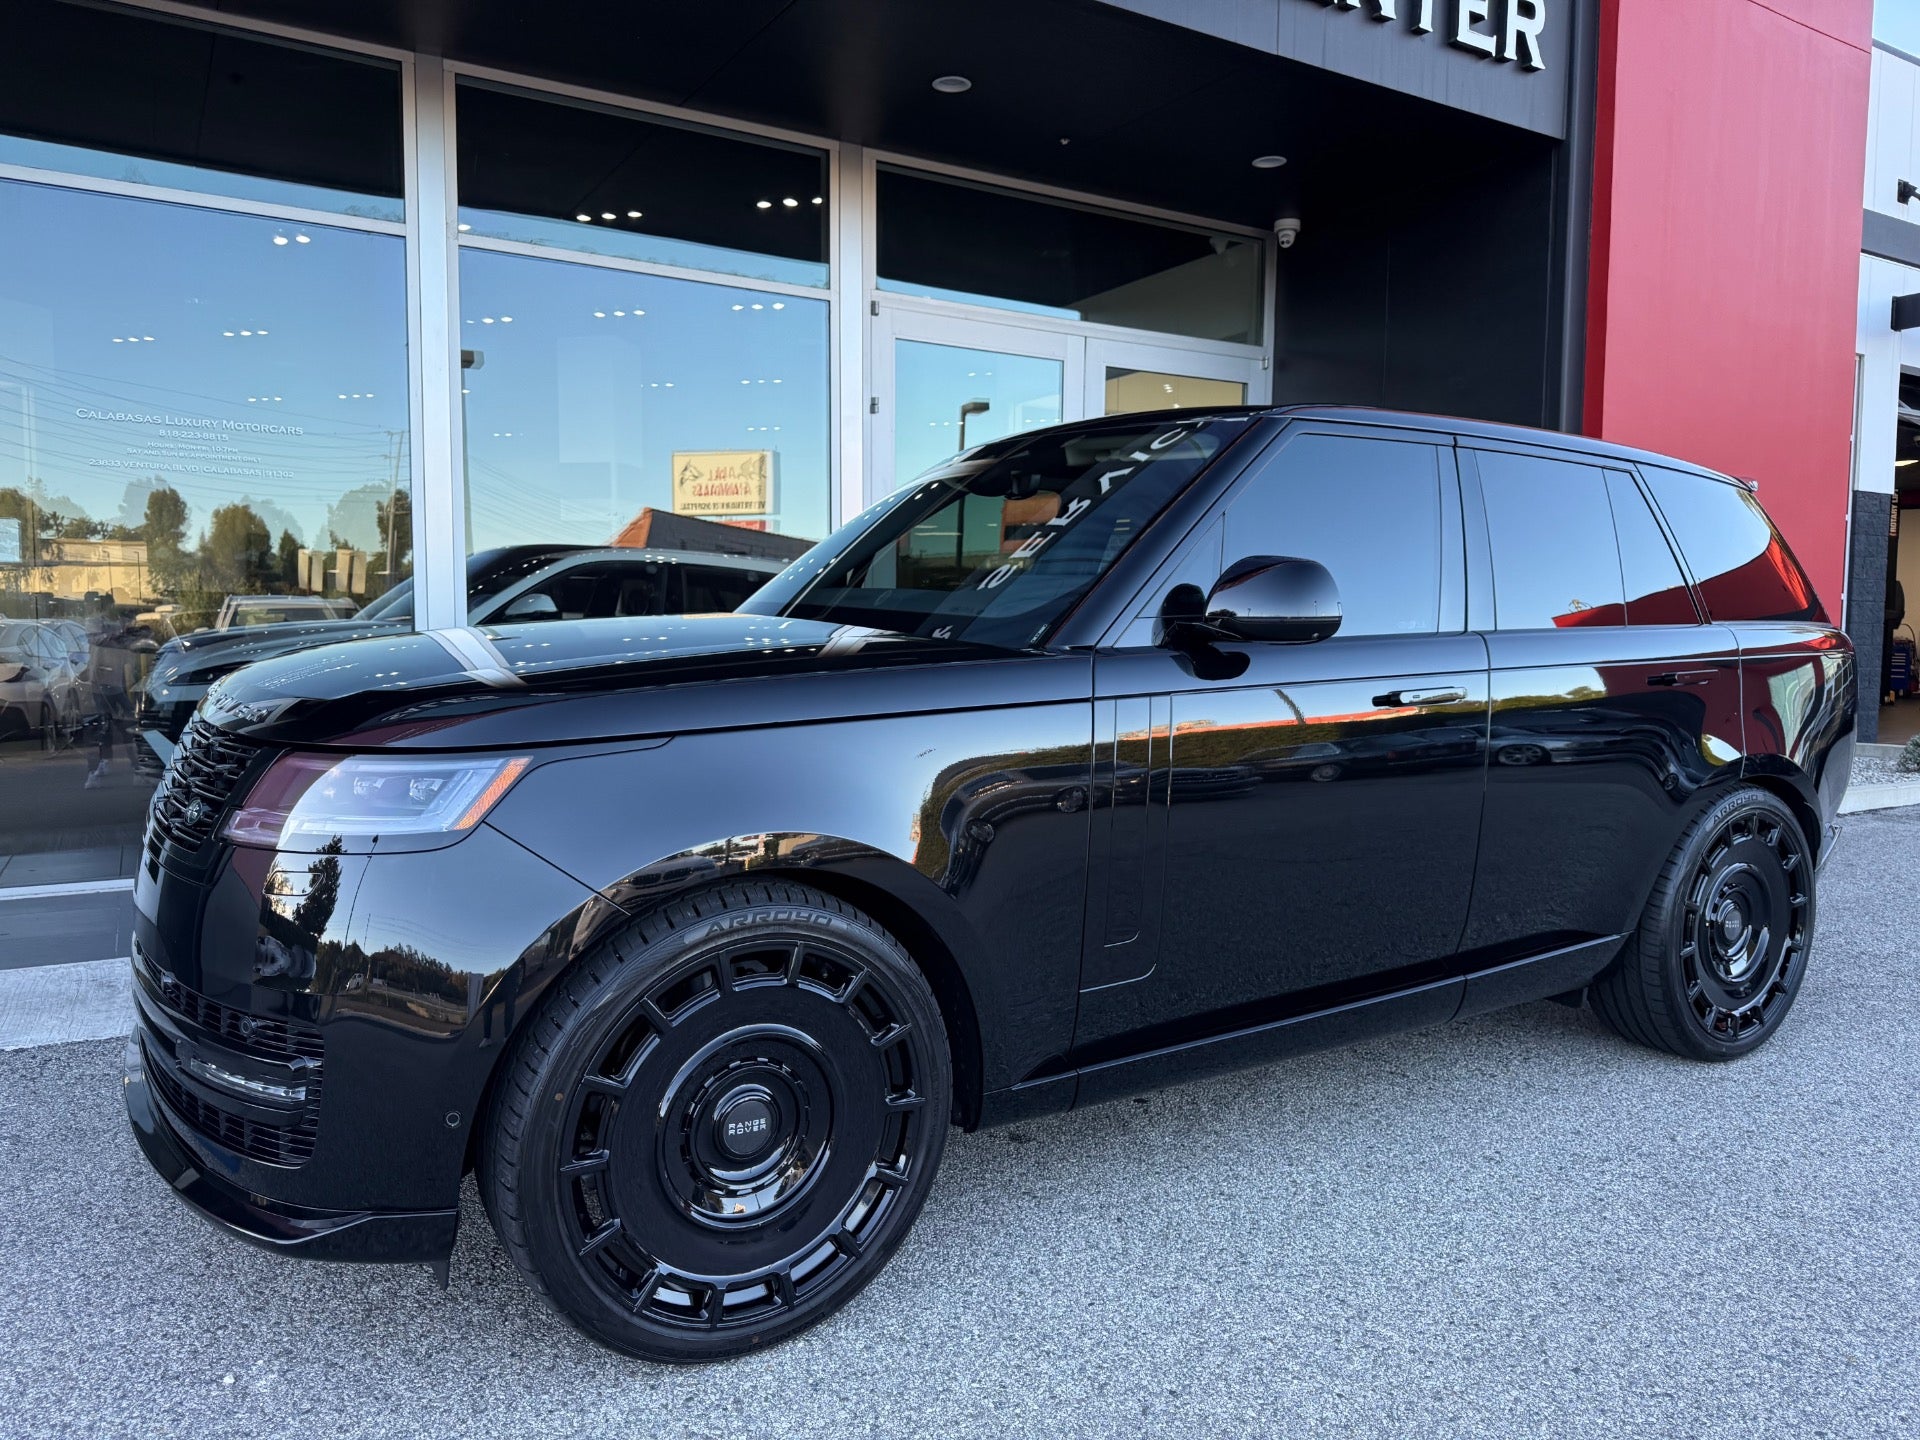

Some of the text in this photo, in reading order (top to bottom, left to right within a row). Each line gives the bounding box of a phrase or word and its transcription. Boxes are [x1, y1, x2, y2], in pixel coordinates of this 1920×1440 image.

[75, 408, 304, 436] CALABASAS LUXURY MOTORCARS
[704, 910, 833, 937] ARROYO
[728, 1118, 766, 1130] RANGE
[728, 1124, 766, 1136] ROVER
